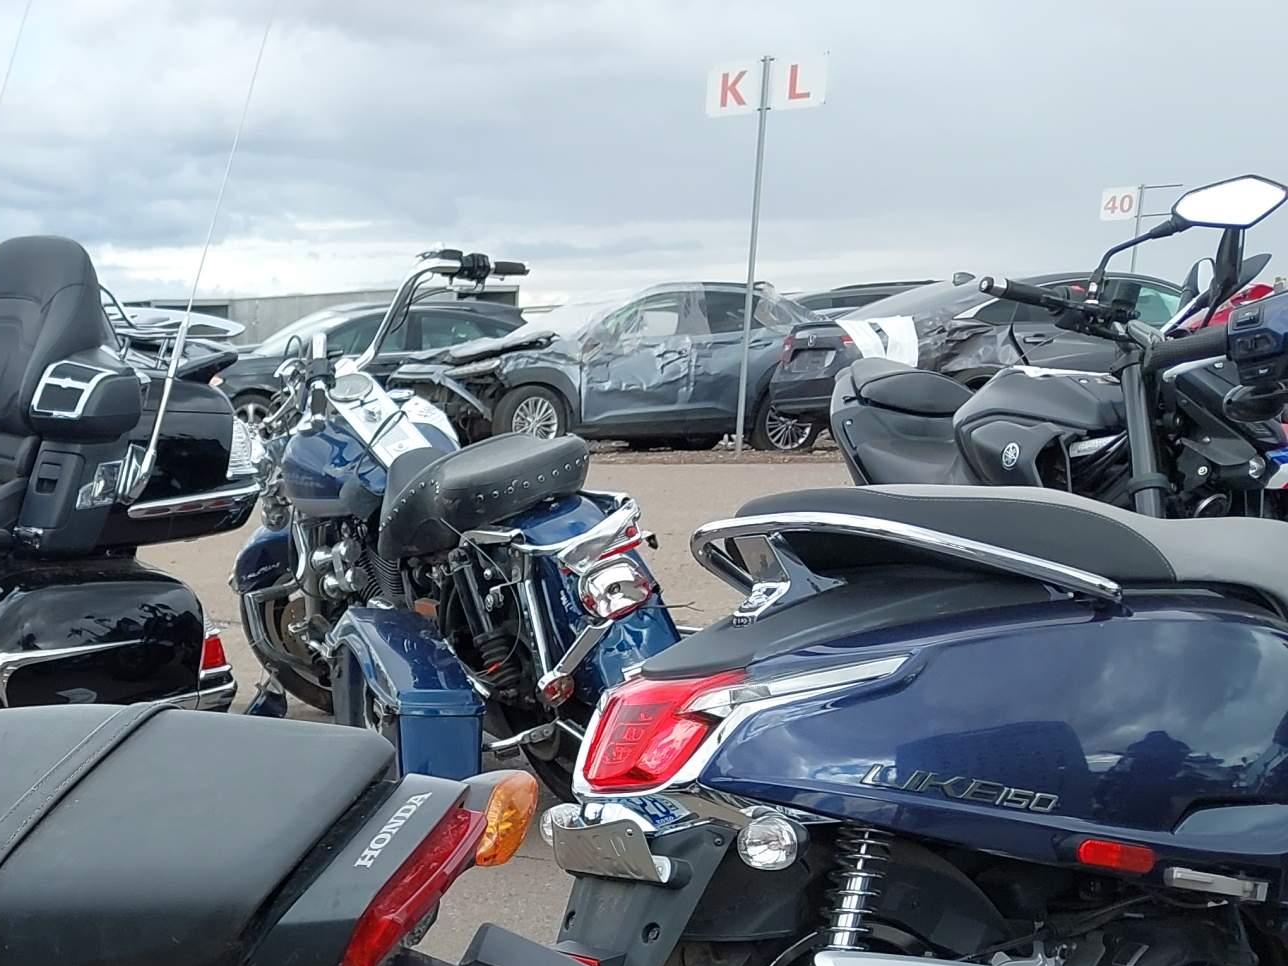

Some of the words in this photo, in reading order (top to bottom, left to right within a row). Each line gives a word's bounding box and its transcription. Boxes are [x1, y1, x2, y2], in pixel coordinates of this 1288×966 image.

[720, 70, 748, 107] K
[788, 64, 810, 100] L
[1104, 194, 1133, 214] 40
[354, 792, 432, 868] HONDA
